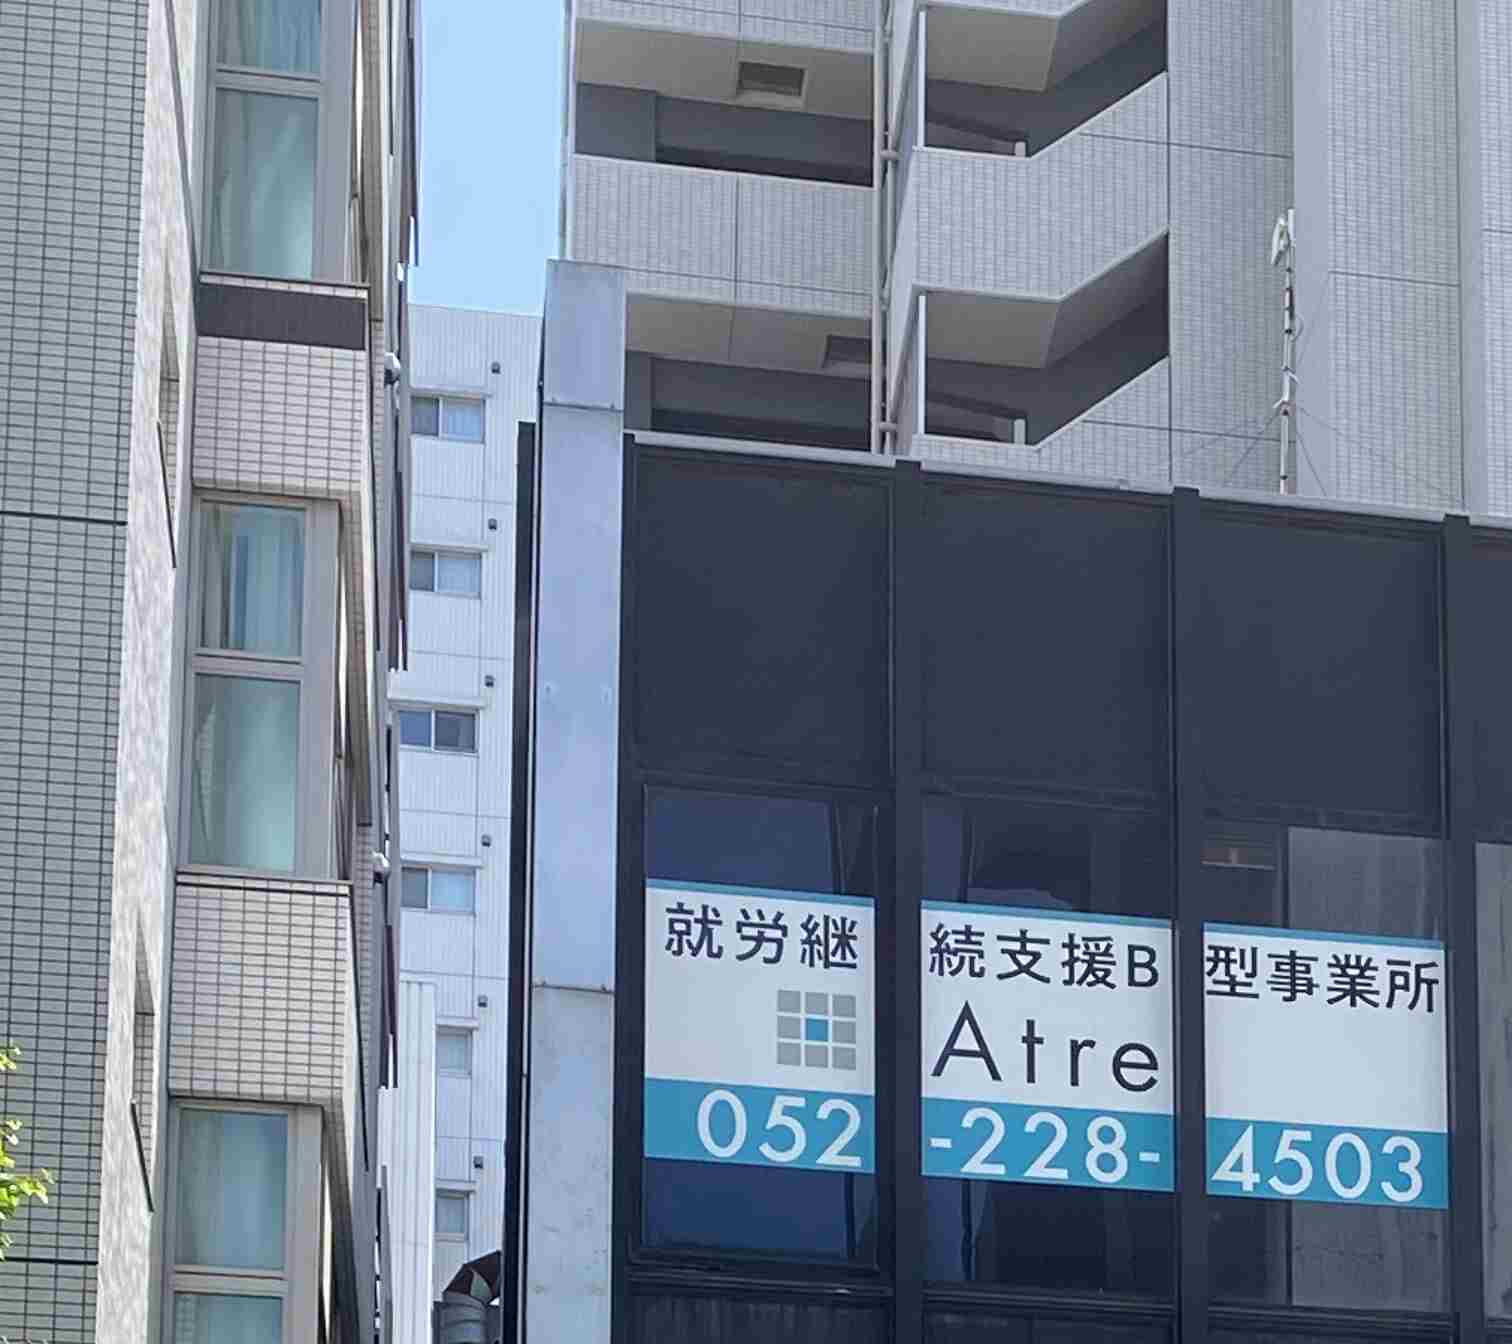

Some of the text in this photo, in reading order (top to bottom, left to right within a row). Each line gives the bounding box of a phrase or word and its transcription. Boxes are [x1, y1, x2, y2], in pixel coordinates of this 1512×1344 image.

[664, 899, 1441, 1013] 就労継 続支援B 型事業所
[931, 999, 1160, 1092] Atre
[696, 1088, 864, 1167] 052
[1209, 1123, 1425, 1203] 4503
